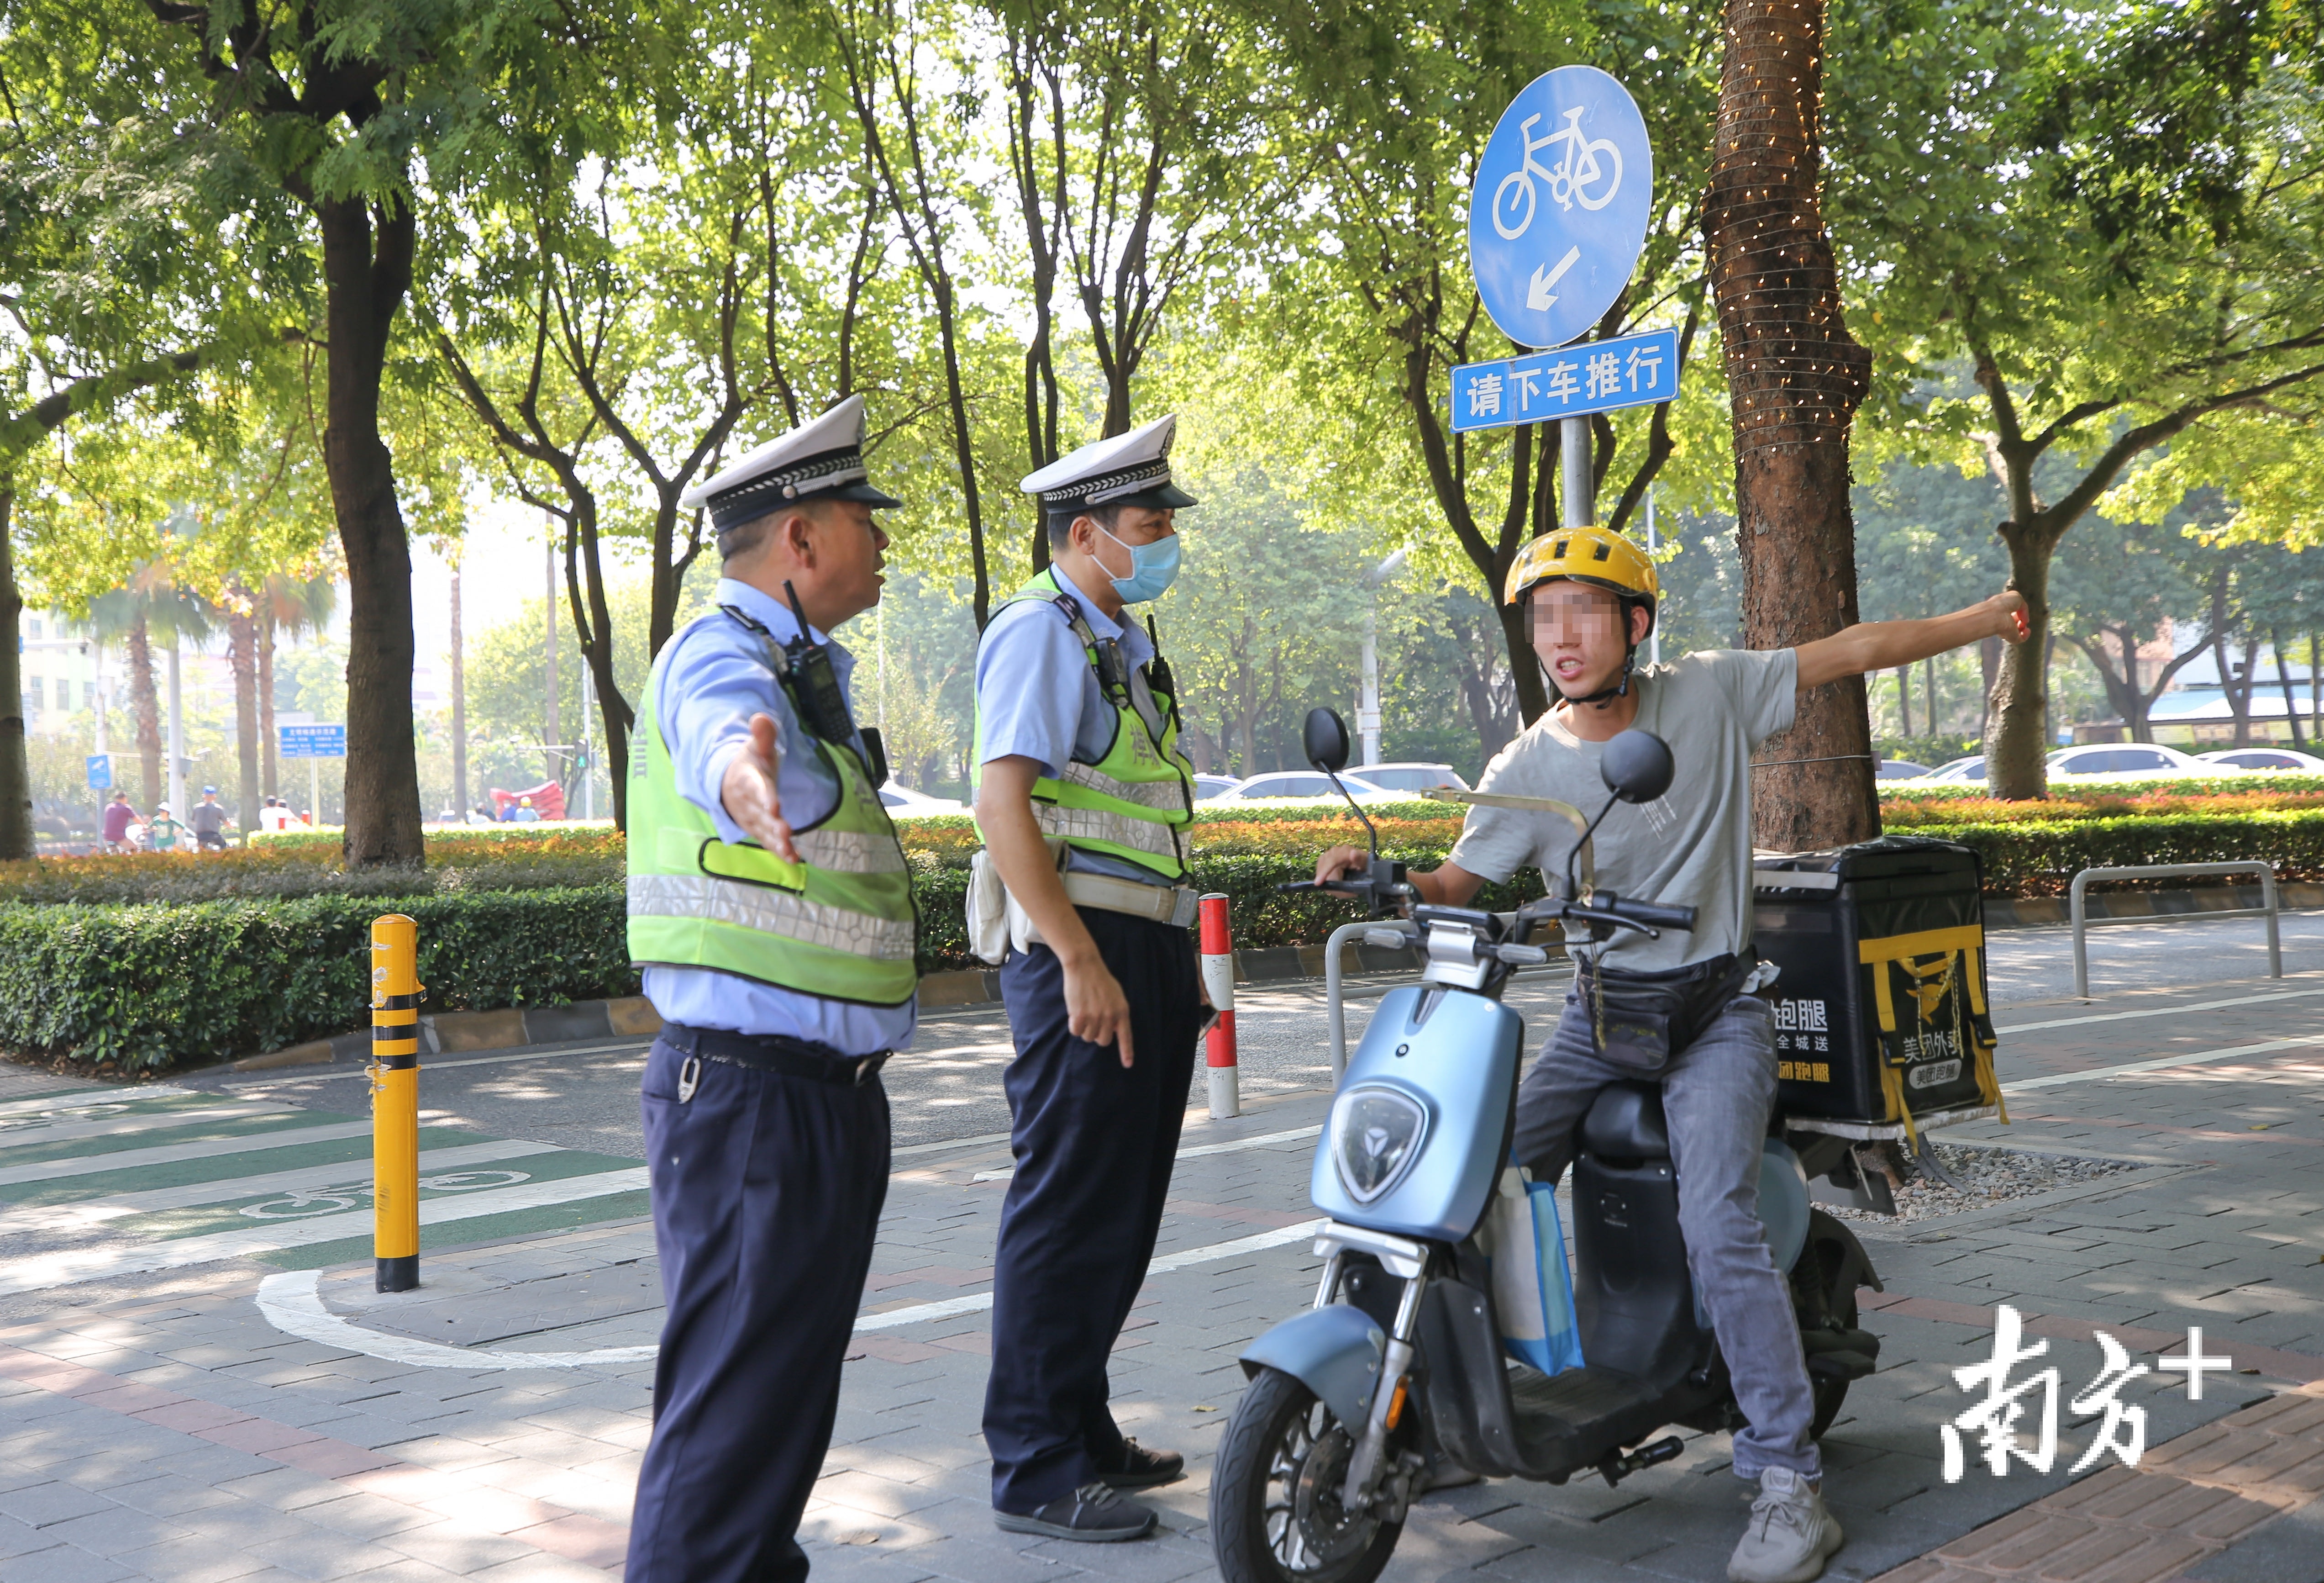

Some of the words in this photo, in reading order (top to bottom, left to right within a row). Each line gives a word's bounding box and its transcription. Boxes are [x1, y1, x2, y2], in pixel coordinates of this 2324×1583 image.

[1467, 345, 1663, 417] 请下车推行
[1777, 1034, 1829, 1051] 全城送
[1778, 1061, 1830, 1082] 团跑腿
[1916, 1063, 1956, 1086] 美团跑腿
